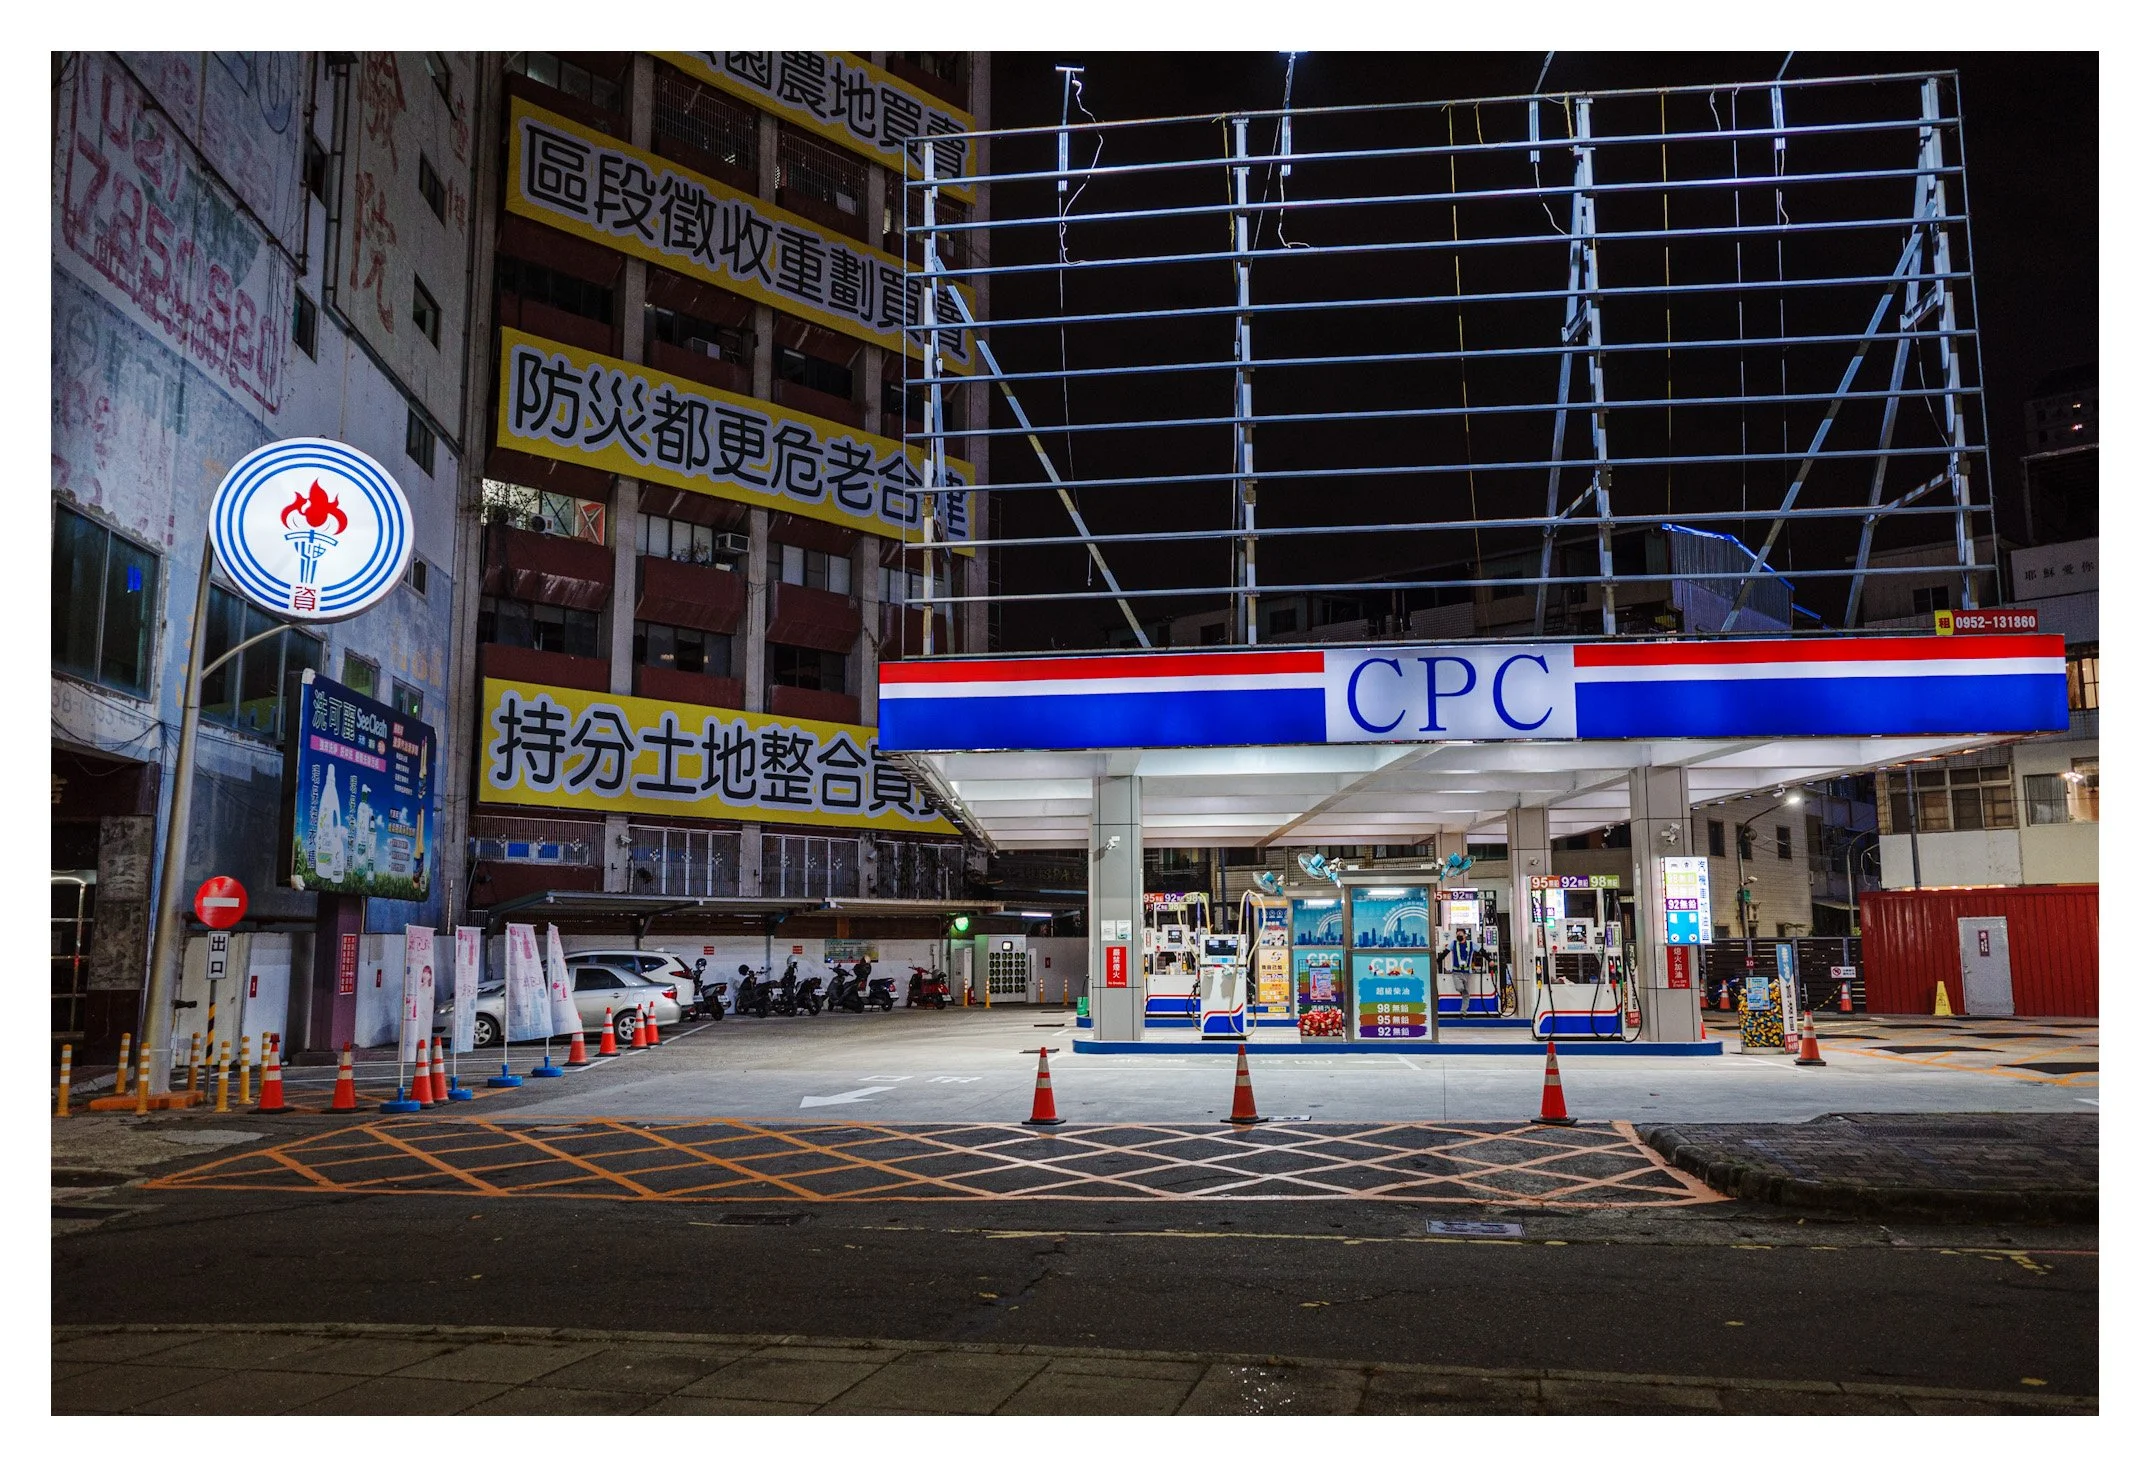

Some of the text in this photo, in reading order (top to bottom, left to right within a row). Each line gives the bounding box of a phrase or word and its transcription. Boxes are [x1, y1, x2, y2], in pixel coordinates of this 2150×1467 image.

[698, 51, 966, 179] 園農地買賣
[525, 123, 966, 359] 區段徵收重劃買賣
[2024, 561, 2095, 581] 耶穌愛你
[293, 586, 316, 611] 資
[1938, 617, 1951, 629] 租
[1955, 615, 2036, 629] 0952-131860
[1347, 654, 1553, 734] CPC
[356, 707, 388, 739] SeeClean
[496, 698, 936, 817] 持分土地整合買
[1668, 899, 1697, 910] 92無鉛
[211, 935, 226, 974] 出口
[1370, 957, 1414, 975] CPC
[1375, 987, 1411, 996] 超級柴油
[1377, 1004, 1409, 1013] 98 無鉛
[1377, 1015, 1410, 1025] 95 無鉛
[1378, 1027, 1410, 1036] 92 無鉛
